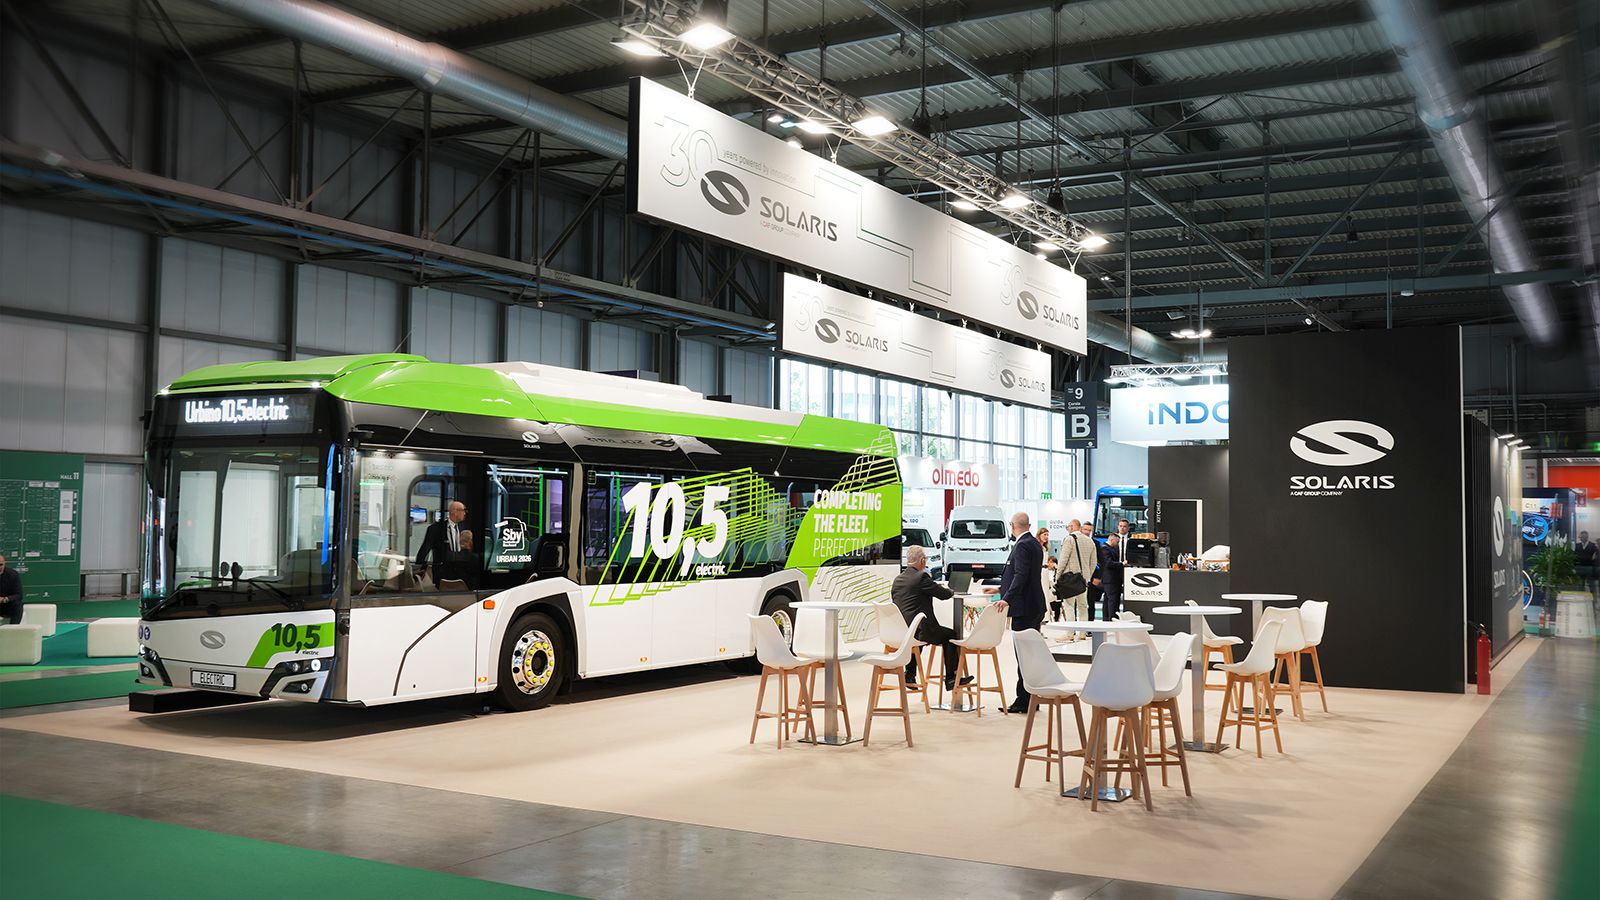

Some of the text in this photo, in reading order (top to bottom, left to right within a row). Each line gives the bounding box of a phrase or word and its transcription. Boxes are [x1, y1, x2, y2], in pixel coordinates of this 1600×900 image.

[760, 196, 838, 242] SOLARIS
[1043, 305, 1080, 330] SOLARIS
[845, 330, 889, 352] SOLARIS
[1018, 377, 1046, 392] SOLARIS
[1075, 387, 1084, 400] 9
[1071, 414, 1091, 438] B
[932, 464, 980, 487] olmedo
[1290, 475, 1396, 489] SOLARIS
[813, 489, 882, 511] COMPLETING
[622, 482, 731, 577] 10,5
[813, 513, 869, 534] THE FLEET.
[502, 528, 522, 544] Sby
[813, 537, 868, 557] PERFECTLY
[496, 555, 532, 563] URBAN 2026
[695, 561, 726, 576] electric
[271, 622, 321, 654] 10,5
[200, 672, 225, 685] ELECTRIC
